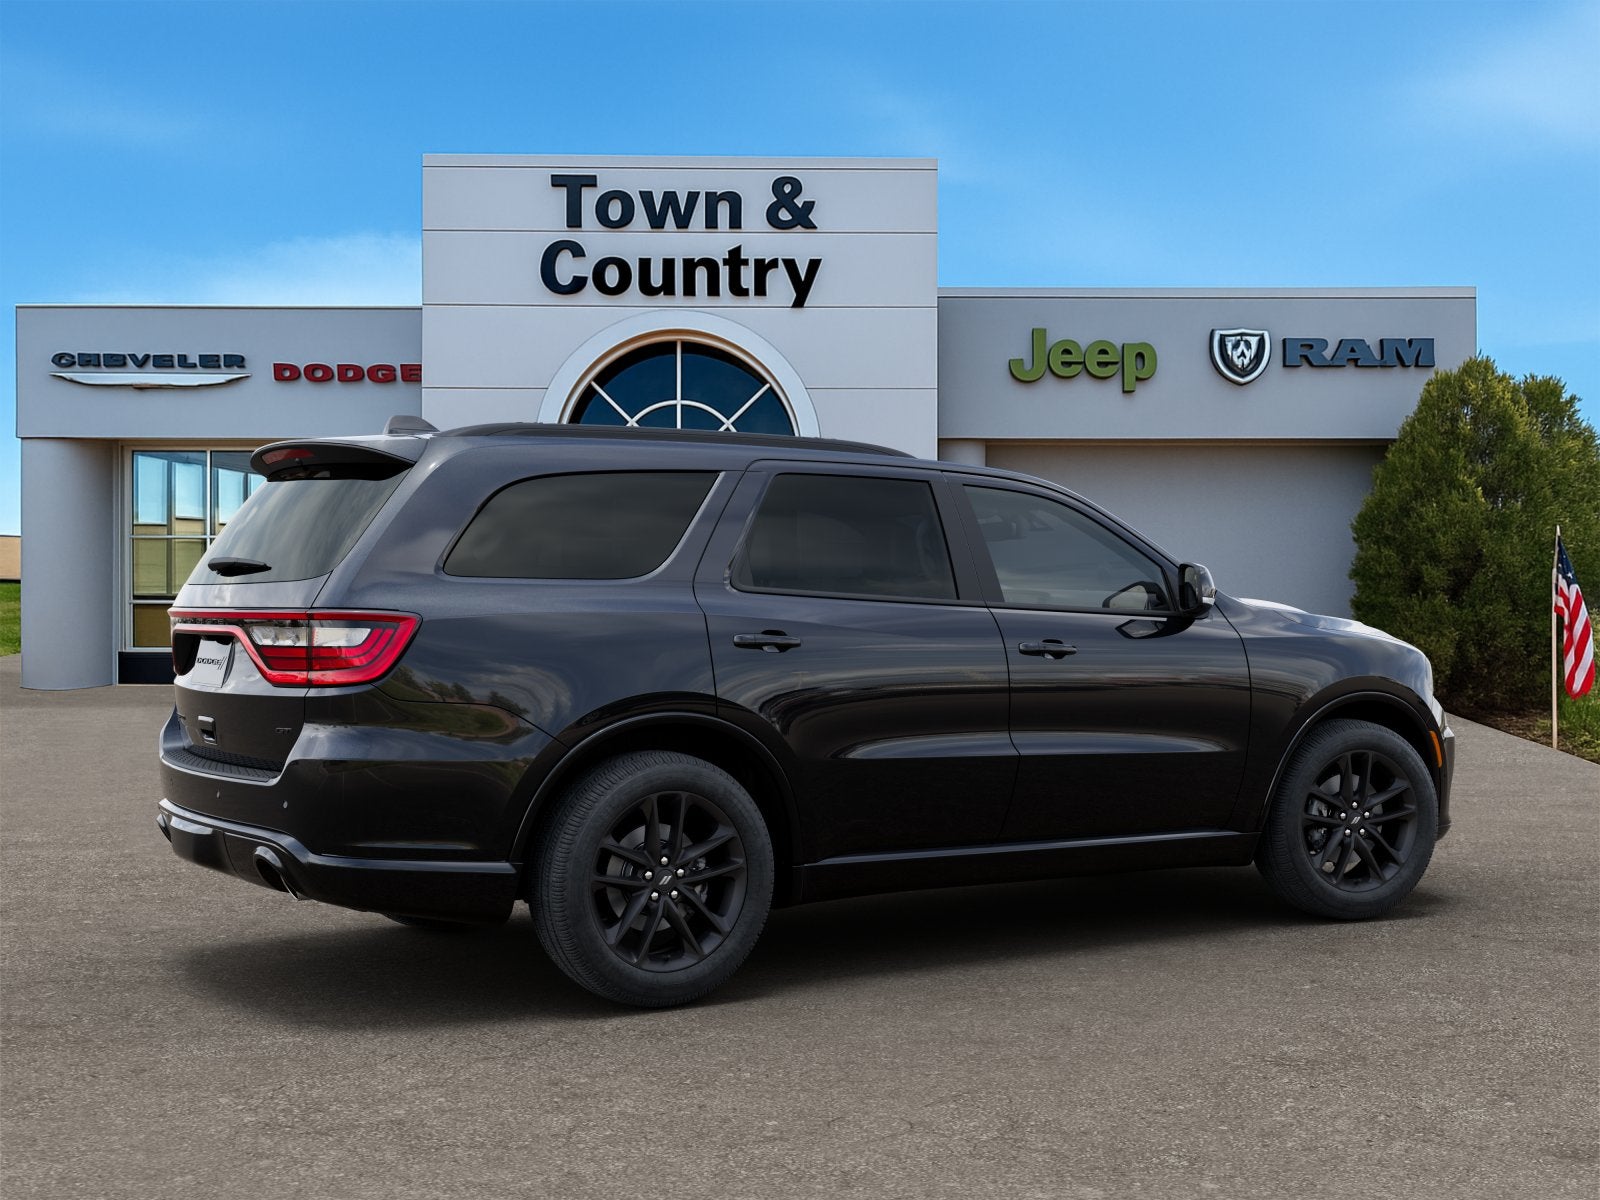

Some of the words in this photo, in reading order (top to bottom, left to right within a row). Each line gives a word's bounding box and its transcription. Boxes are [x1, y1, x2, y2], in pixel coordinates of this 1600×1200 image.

[551, 174, 742, 229] Town
[765, 176, 818, 230] &
[540, 239, 822, 309] Country
[273, 363, 421, 383] DODGE
[1009, 328, 1157, 393] Jeep
[1283, 337, 1435, 368] RAM
